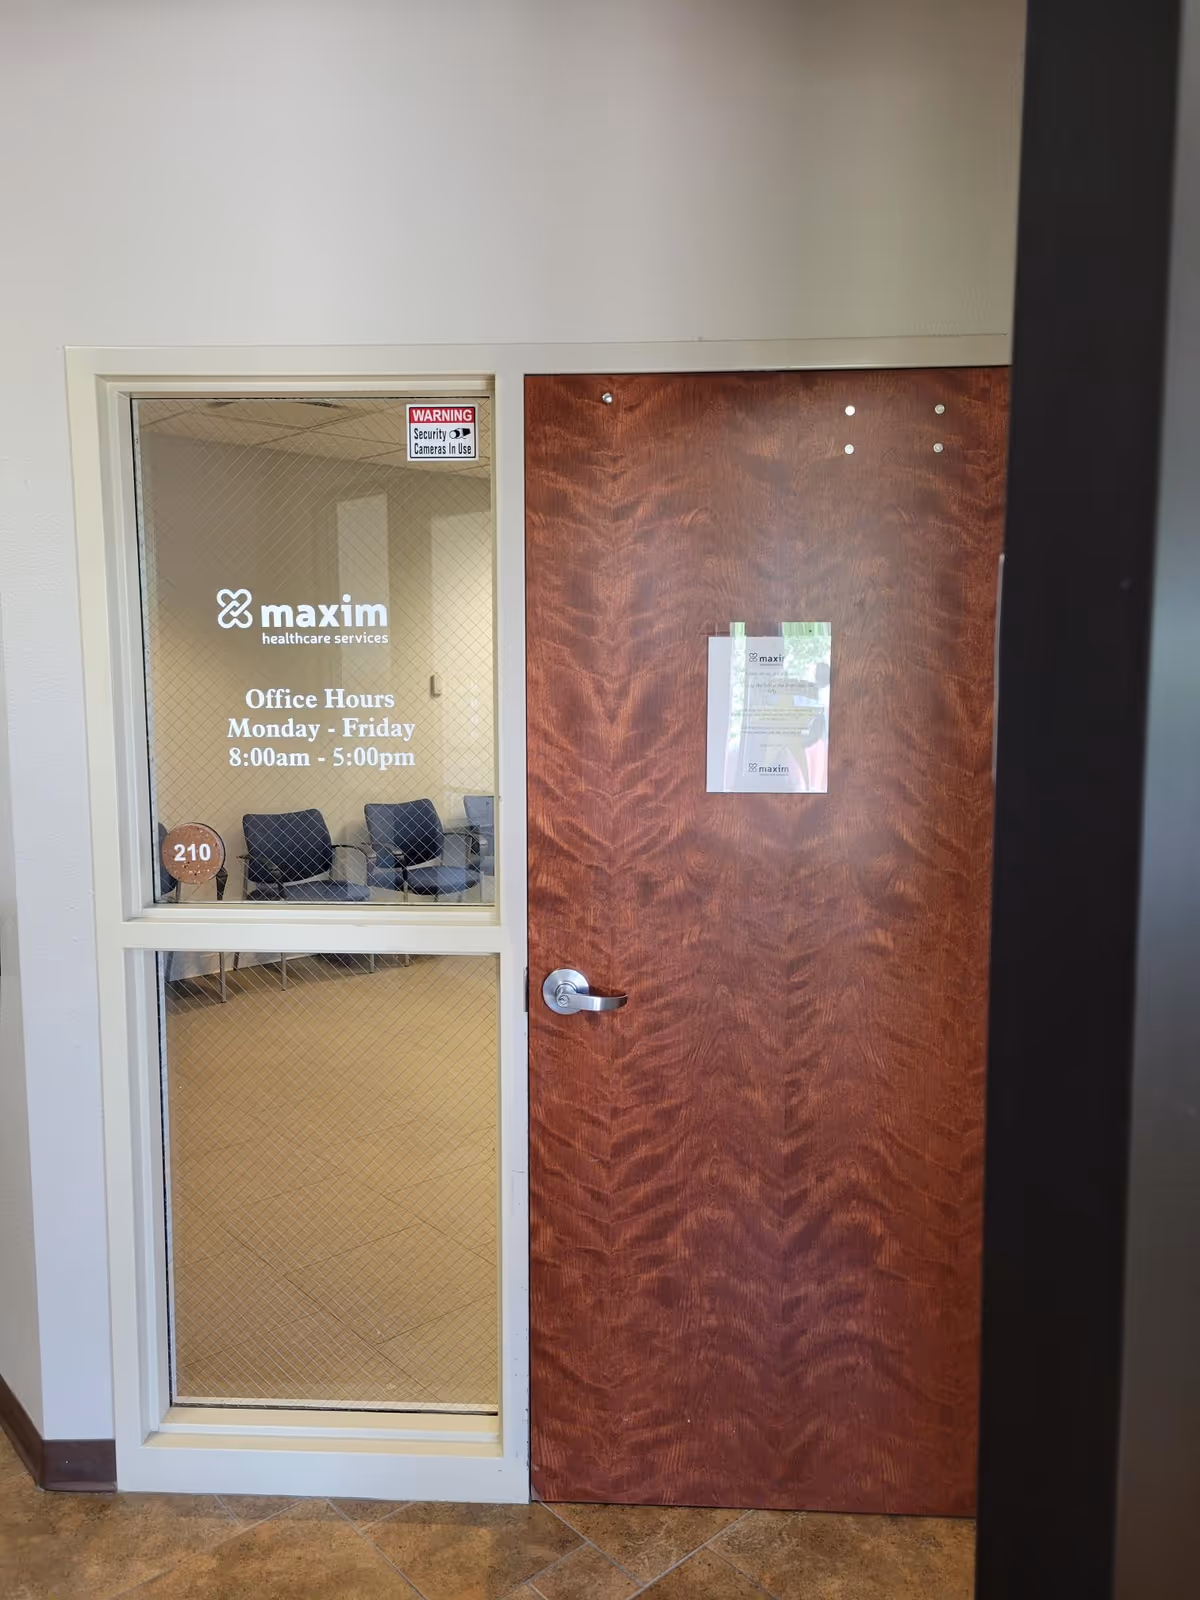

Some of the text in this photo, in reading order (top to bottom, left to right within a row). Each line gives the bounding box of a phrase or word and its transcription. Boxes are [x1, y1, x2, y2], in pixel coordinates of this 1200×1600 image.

[412, 409, 473, 422] WARNING
[413, 427, 447, 442] Security
[414, 442, 472, 455] Cameras In Use
[260, 593, 388, 628] maxim
[262, 632, 389, 645] healthcare services
[245, 688, 395, 709] Office Hours
[226, 717, 320, 742] Monday
[342, 717, 416, 742] Friday
[228, 747, 311, 767] 8:00am
[332, 746, 416, 771] 5:00pm
[758, 764, 790, 773] maxim
[173, 843, 211, 862] 210
